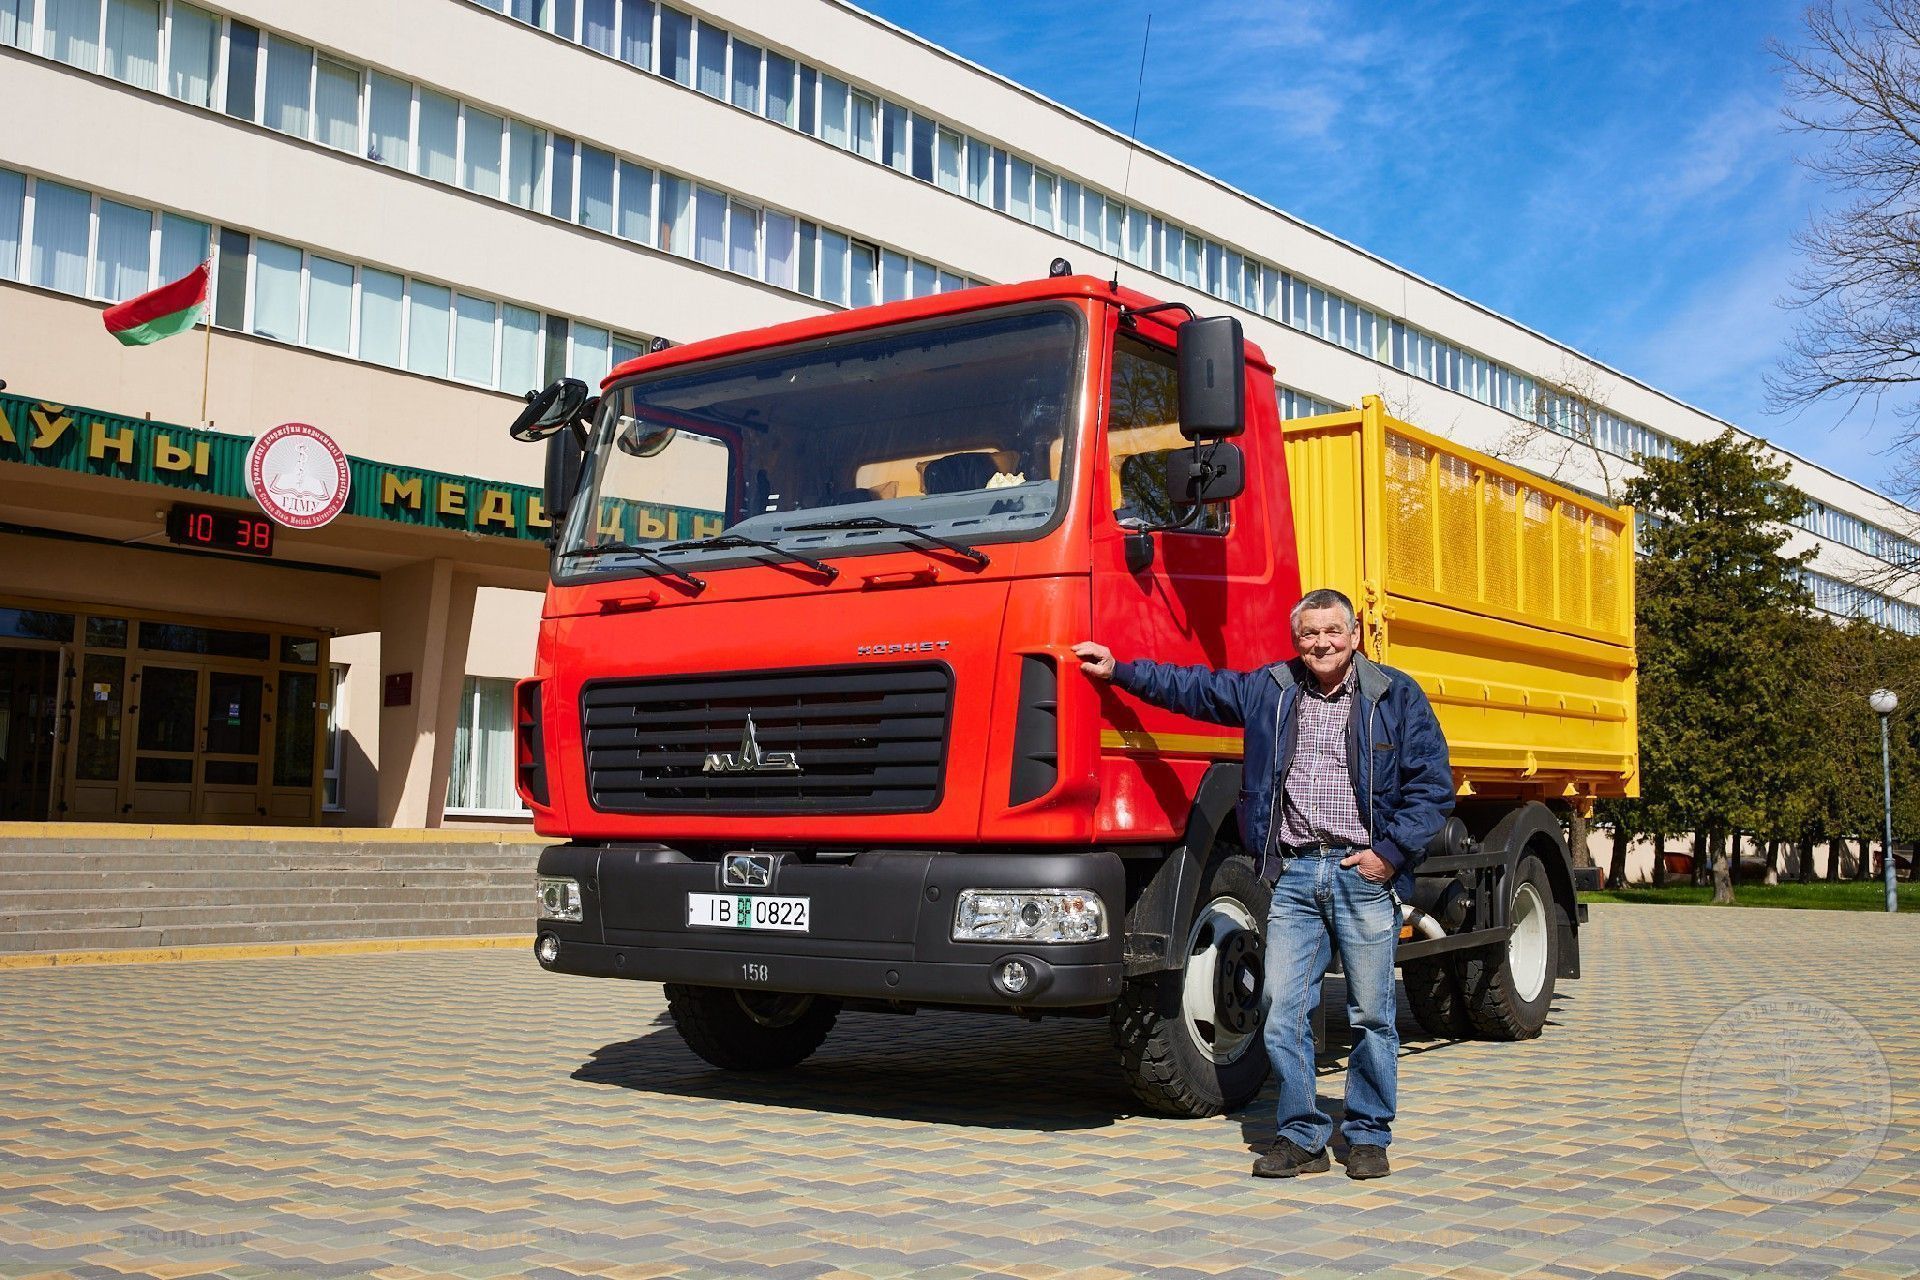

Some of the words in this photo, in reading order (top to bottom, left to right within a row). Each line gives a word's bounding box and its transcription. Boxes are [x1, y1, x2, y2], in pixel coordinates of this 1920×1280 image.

[188, 513, 213, 542] 10
[236, 520, 270, 549] 38
[756, 901, 805, 926] 0822
[742, 963, 769, 982] 158
